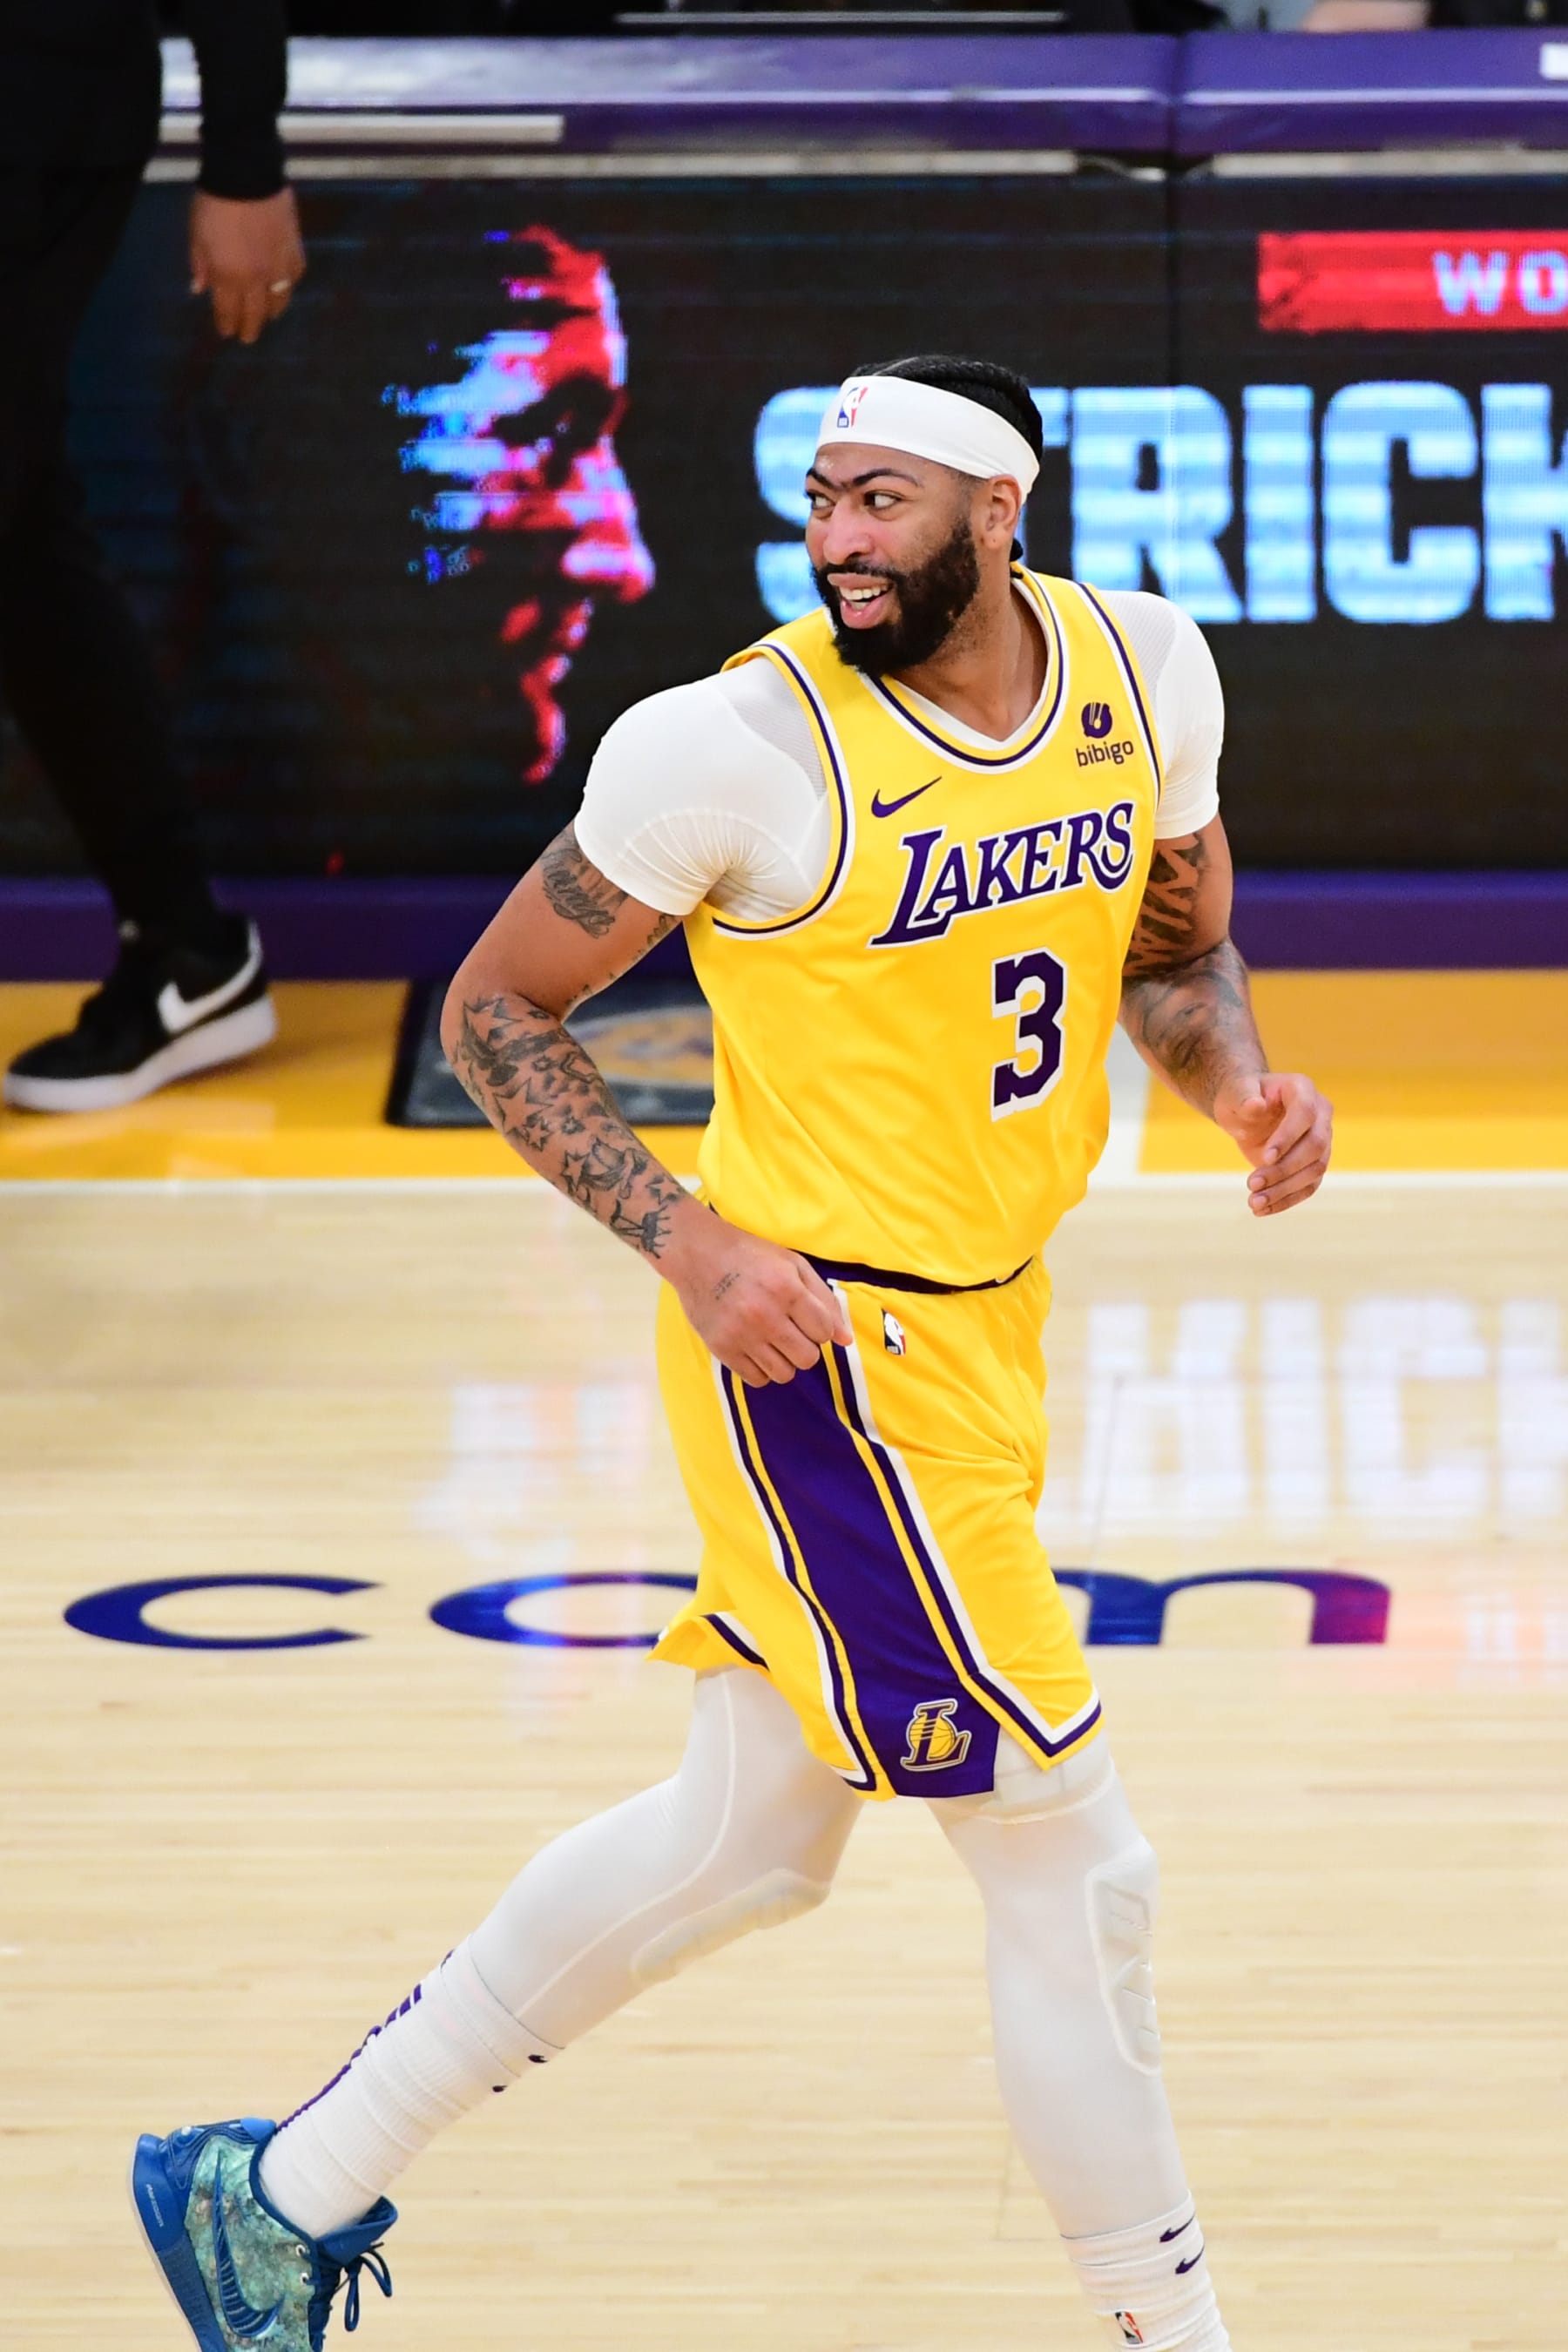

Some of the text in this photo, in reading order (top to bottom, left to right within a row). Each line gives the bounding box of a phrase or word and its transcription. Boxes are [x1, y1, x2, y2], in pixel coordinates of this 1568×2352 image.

[1433, 250, 1568, 316] WO
[753, 382, 1568, 625] RICK
[1075, 740, 1134, 767] bibigo
[866, 799, 1136, 950] LAKERS
[990, 946, 1068, 1123] 3
[64, 1571, 1391, 1649] com
